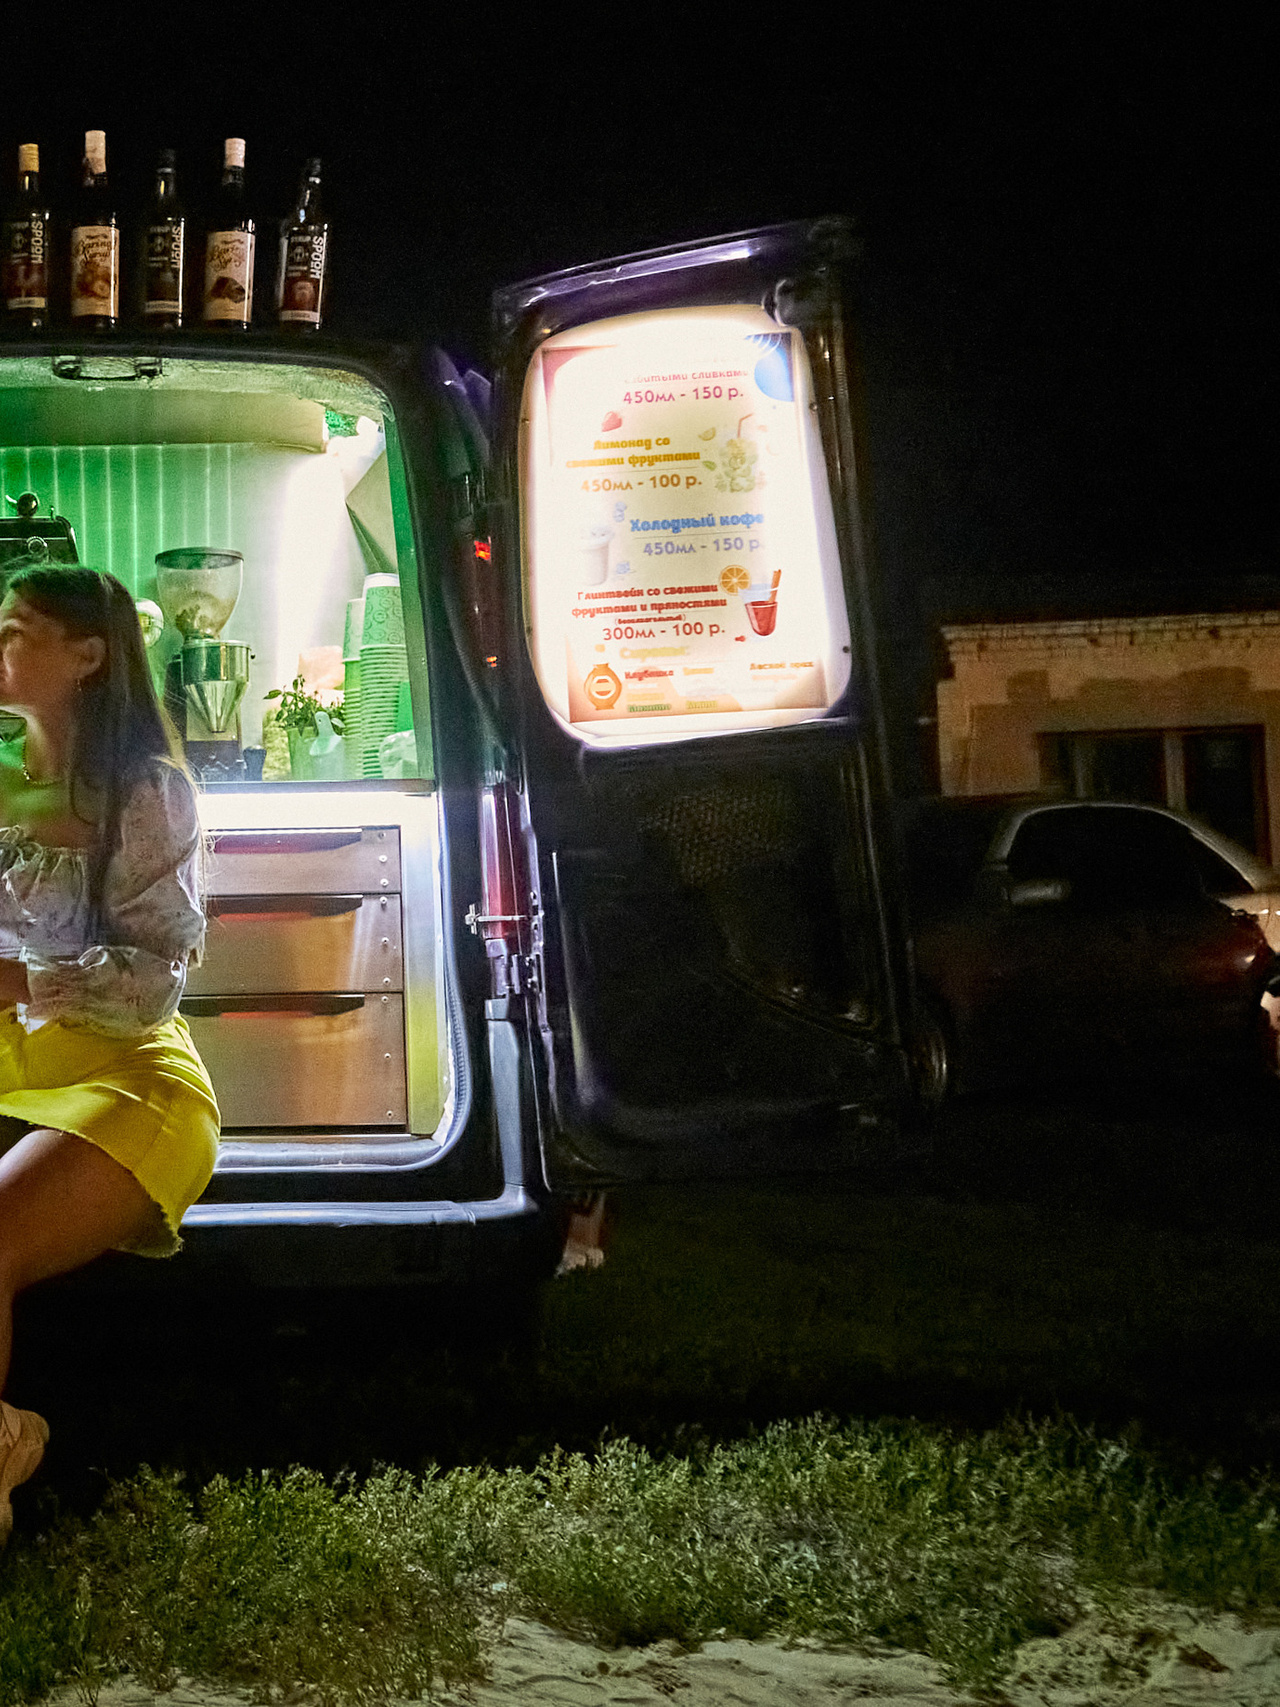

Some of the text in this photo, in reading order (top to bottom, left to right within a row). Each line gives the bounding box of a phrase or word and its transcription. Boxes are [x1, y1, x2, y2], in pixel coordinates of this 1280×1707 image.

[624, 369, 750, 384] битыми сливками
[623, 390, 676, 405] 450мл
[692, 385, 723, 400] 150
[728, 386, 744, 401] р.
[593, 436, 671, 451] Лимонад со
[565, 451, 701, 469] сими фруктами
[580, 478, 633, 493] 450мл
[649, 473, 682, 489] 100
[685, 475, 703, 490] р.
[630, 512, 765, 534] Холодный кофе
[643, 541, 697, 557] 450мл
[713, 537, 744, 552] 150
[577, 583, 719, 601] Глинтвейн со свежими
[571, 598, 728, 619] фруктами и пряностями
[602, 626, 656, 641] 300мл
[672, 621, 704, 637] 100
[708, 622, 726, 637] р.
